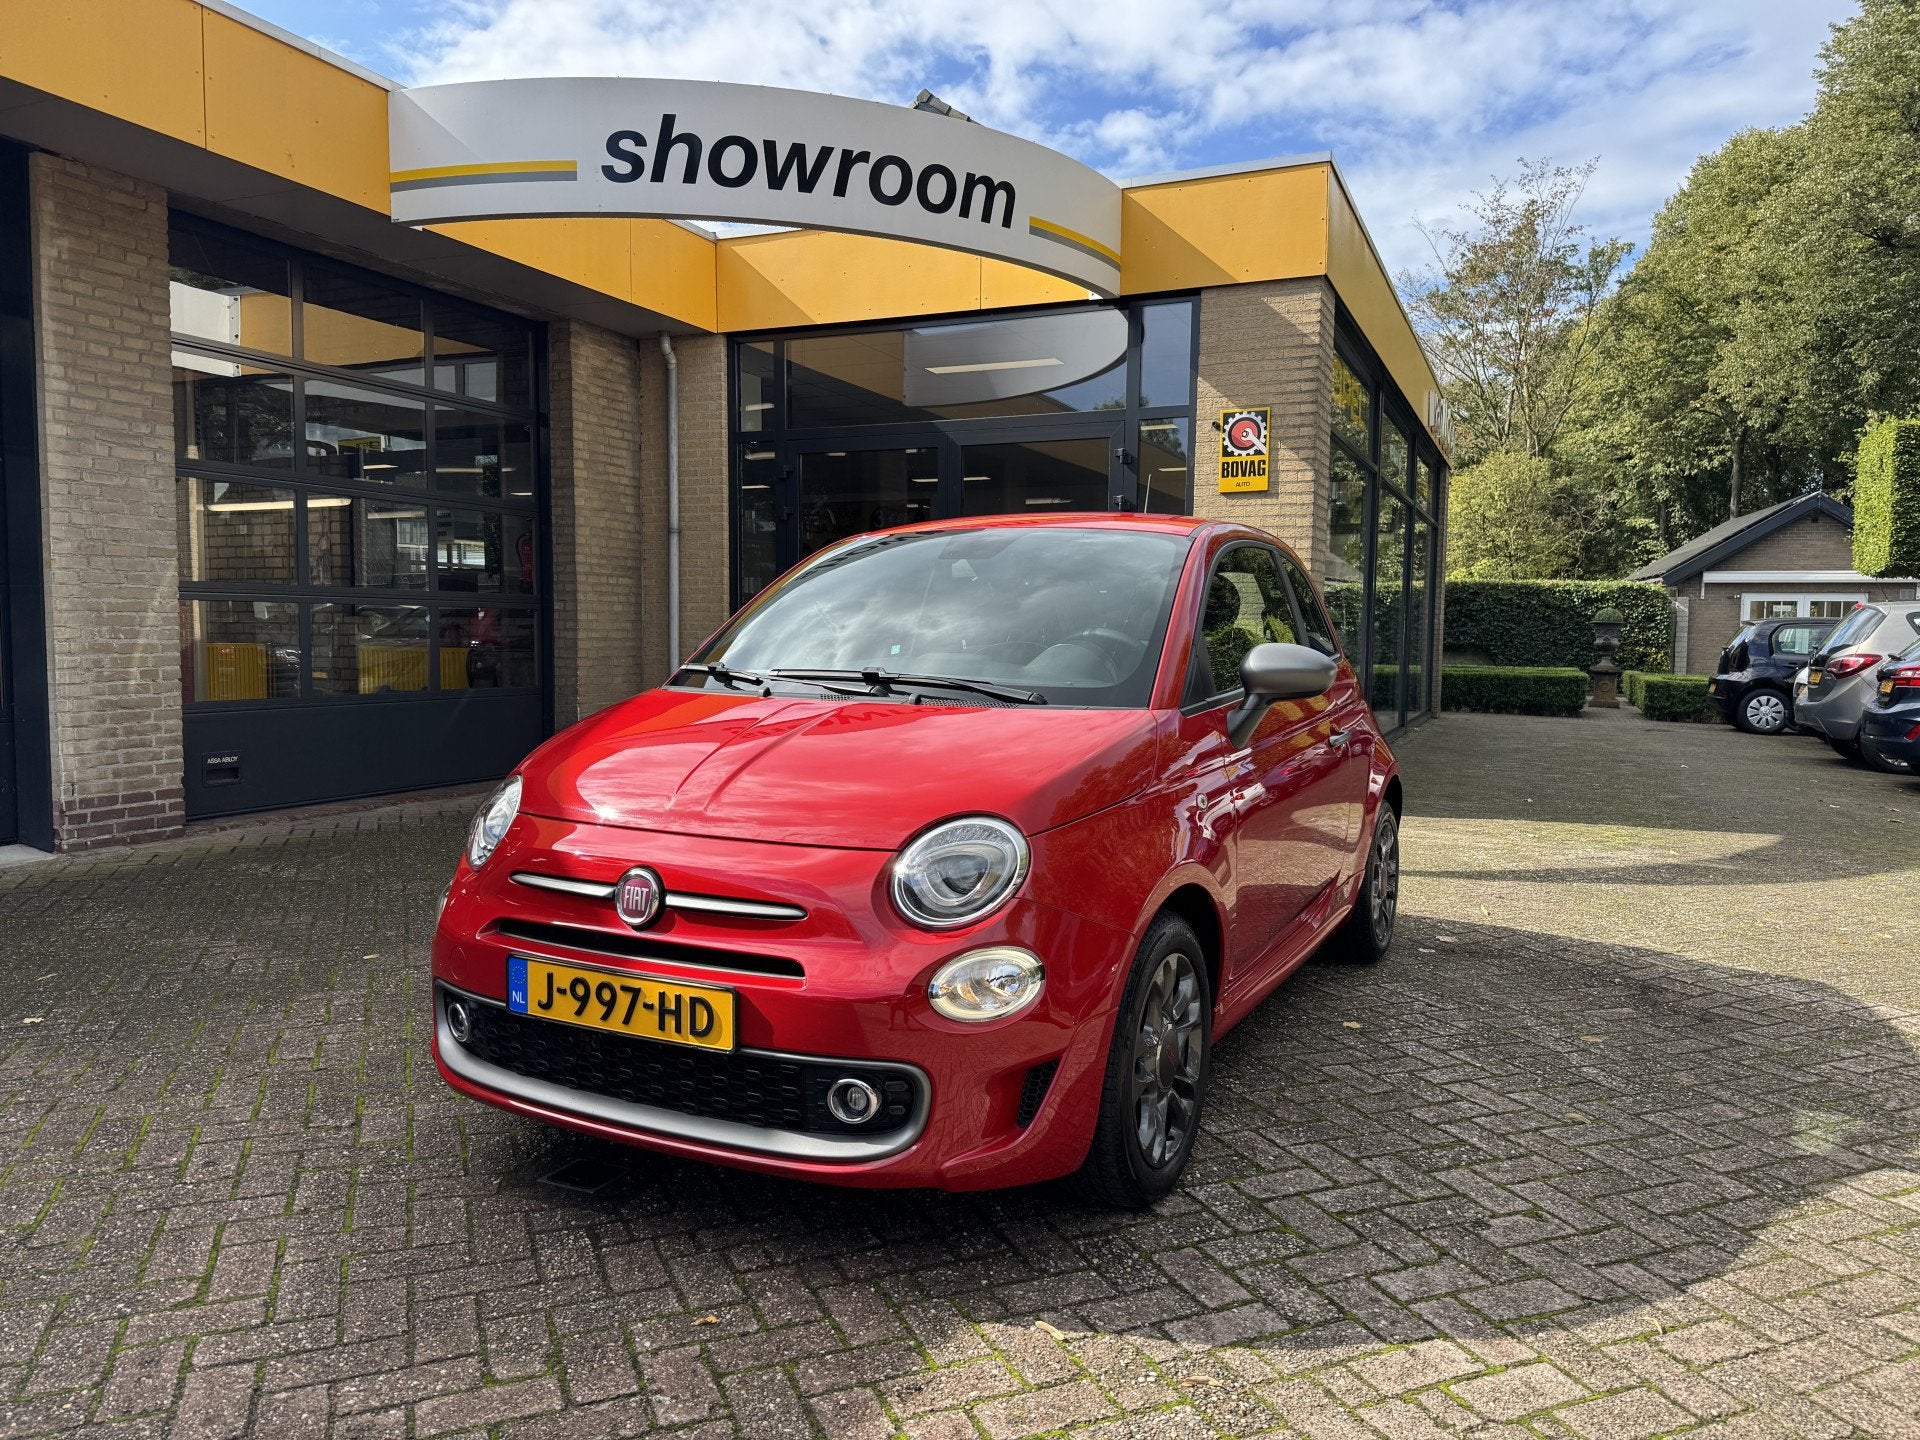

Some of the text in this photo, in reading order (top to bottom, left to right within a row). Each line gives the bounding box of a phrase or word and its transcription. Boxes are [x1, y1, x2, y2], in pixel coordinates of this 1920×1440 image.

[600, 113, 1017, 229] showroom
[1221, 459, 1266, 478] BOVAG
[623, 885, 650, 911] FIAT
[512, 990, 526, 1004] NL
[537, 972, 715, 1038] J-997-HD
